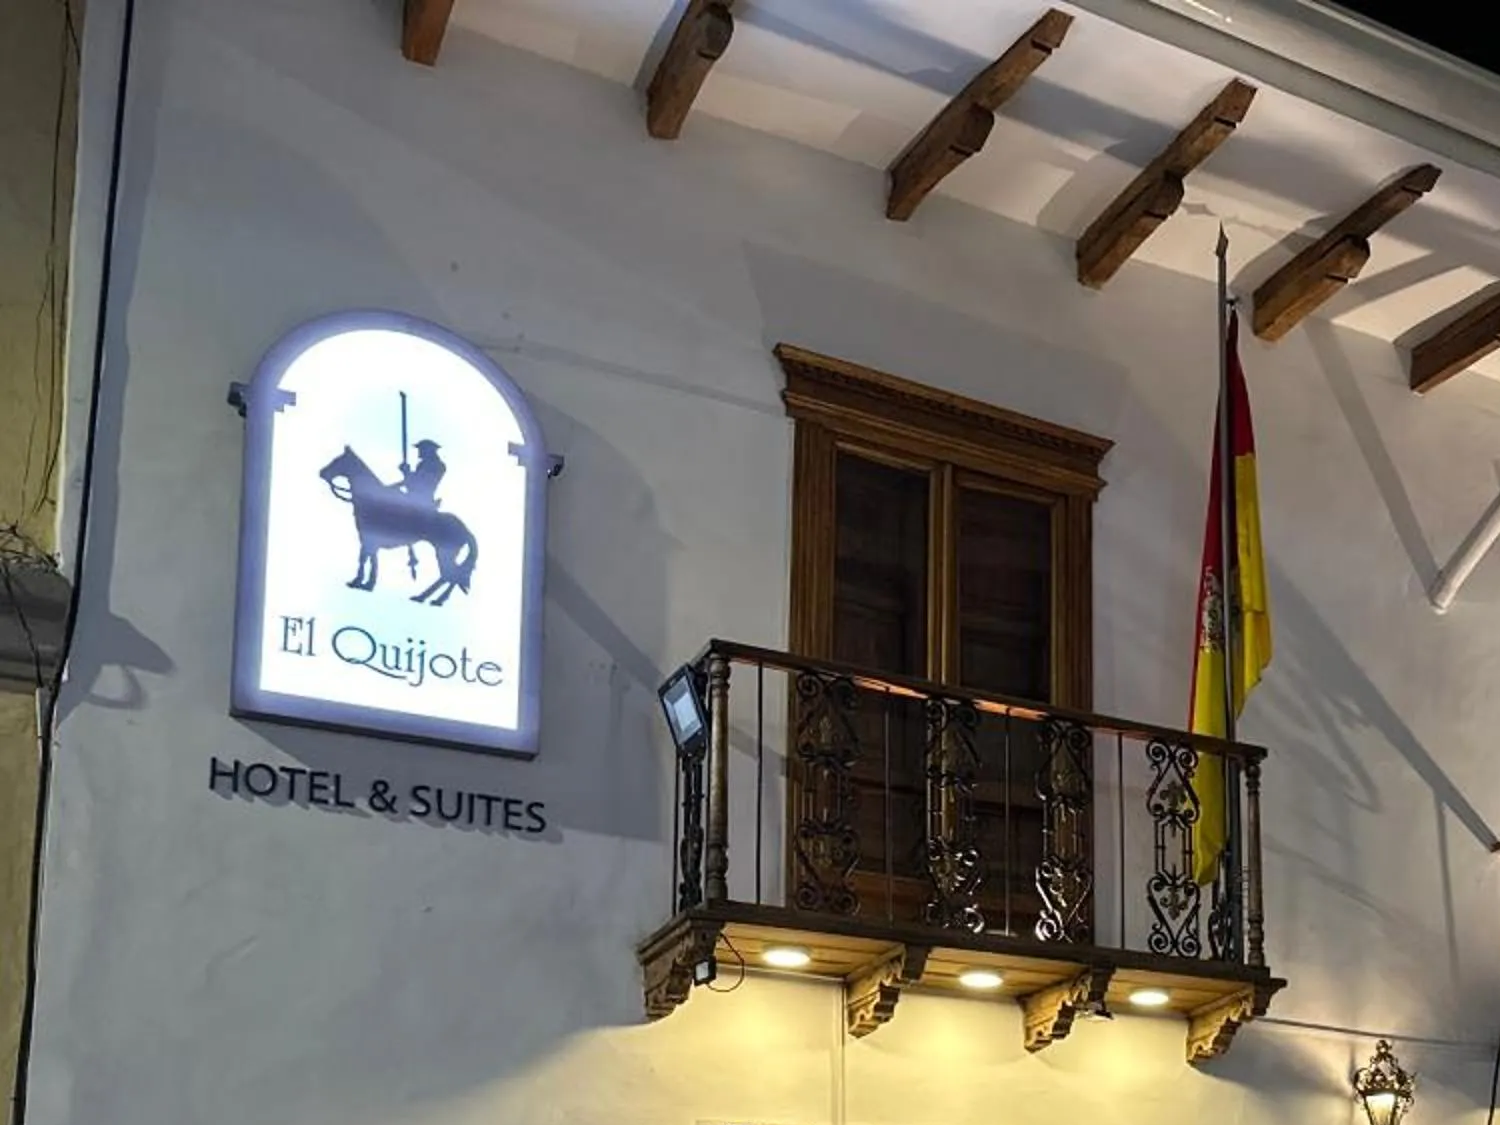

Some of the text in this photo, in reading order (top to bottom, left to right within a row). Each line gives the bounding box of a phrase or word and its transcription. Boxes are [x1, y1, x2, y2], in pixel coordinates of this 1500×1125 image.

[280, 615, 503, 687] El Quijote
[208, 757, 547, 833] HOTEL & SUITES
